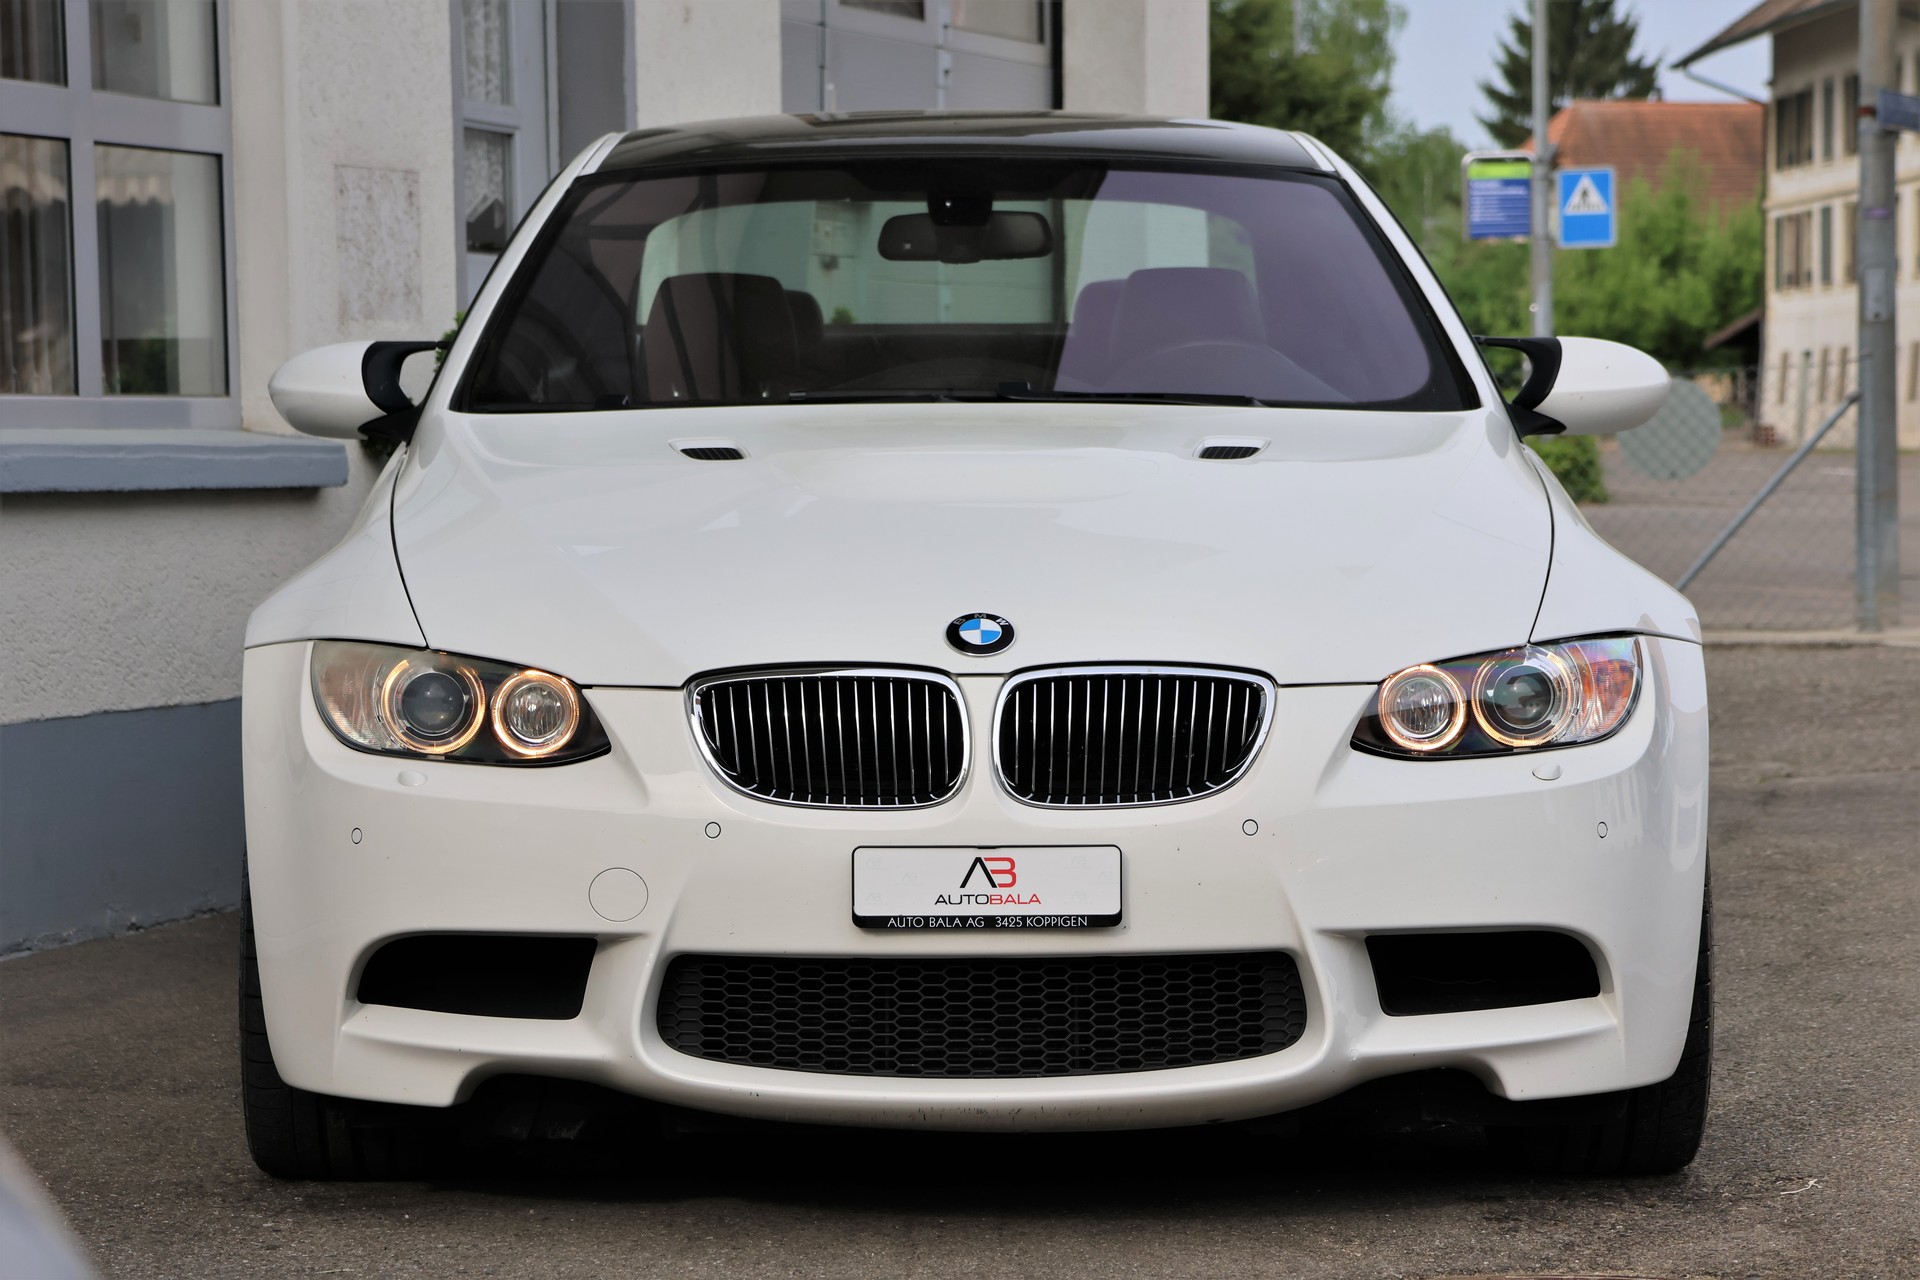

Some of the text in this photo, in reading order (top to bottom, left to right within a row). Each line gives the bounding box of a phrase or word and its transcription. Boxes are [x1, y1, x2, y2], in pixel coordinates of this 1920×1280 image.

[953, 613, 1009, 626] BMW
[959, 856, 1017, 888] AB
[934, 893, 1042, 905] AUTOBALA
[887, 915, 1088, 928] AUTO BALA AG 3425 KOPPIGEN
